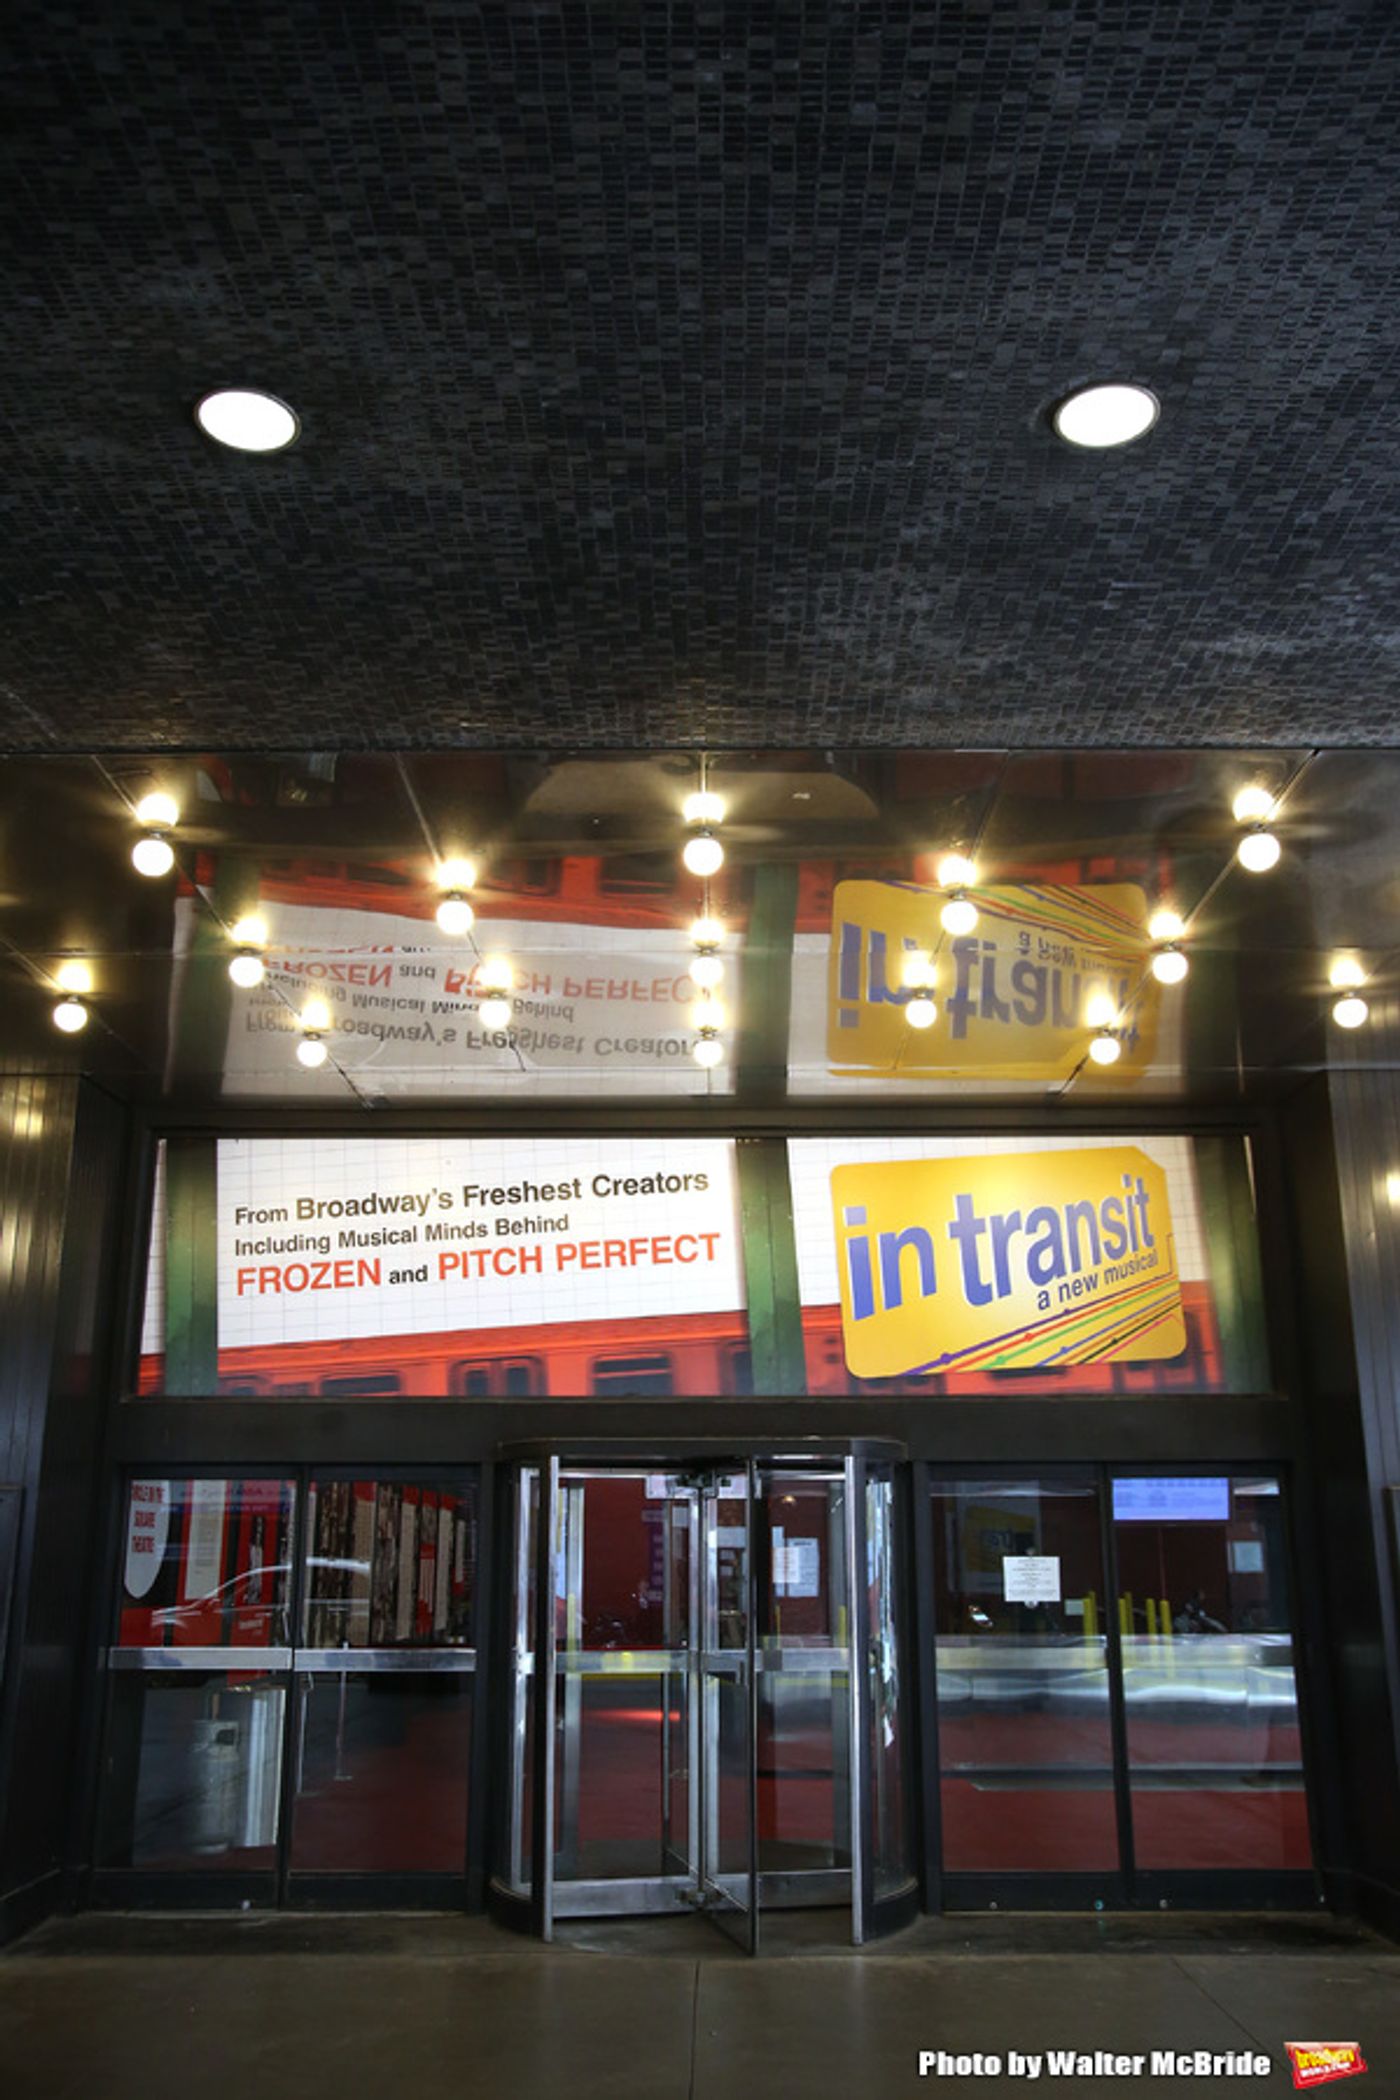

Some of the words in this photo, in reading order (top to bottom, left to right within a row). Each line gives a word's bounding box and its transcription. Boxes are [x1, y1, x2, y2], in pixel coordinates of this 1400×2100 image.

[235, 1206, 288, 1226] From
[296, 1188, 454, 1221] Broadway's
[463, 1177, 582, 1208] Freshest
[591, 1171, 709, 1198] Creators
[235, 1234, 331, 1256] Including
[338, 1226, 418, 1249] Musical
[425, 1220, 489, 1242] Minds
[495, 1213, 569, 1237] Behind
[237, 1257, 382, 1297] FROZEN
[389, 1264, 429, 1285] and
[438, 1244, 542, 1280] PITCH
[556, 1232, 721, 1272] PERFECT
[842, 1205, 938, 1322] in
[947, 1172, 1155, 1308] transit
[1037, 1290, 1051, 1311] a
[1058, 1273, 1099, 1303] new
[1104, 1248, 1159, 1285] musical
